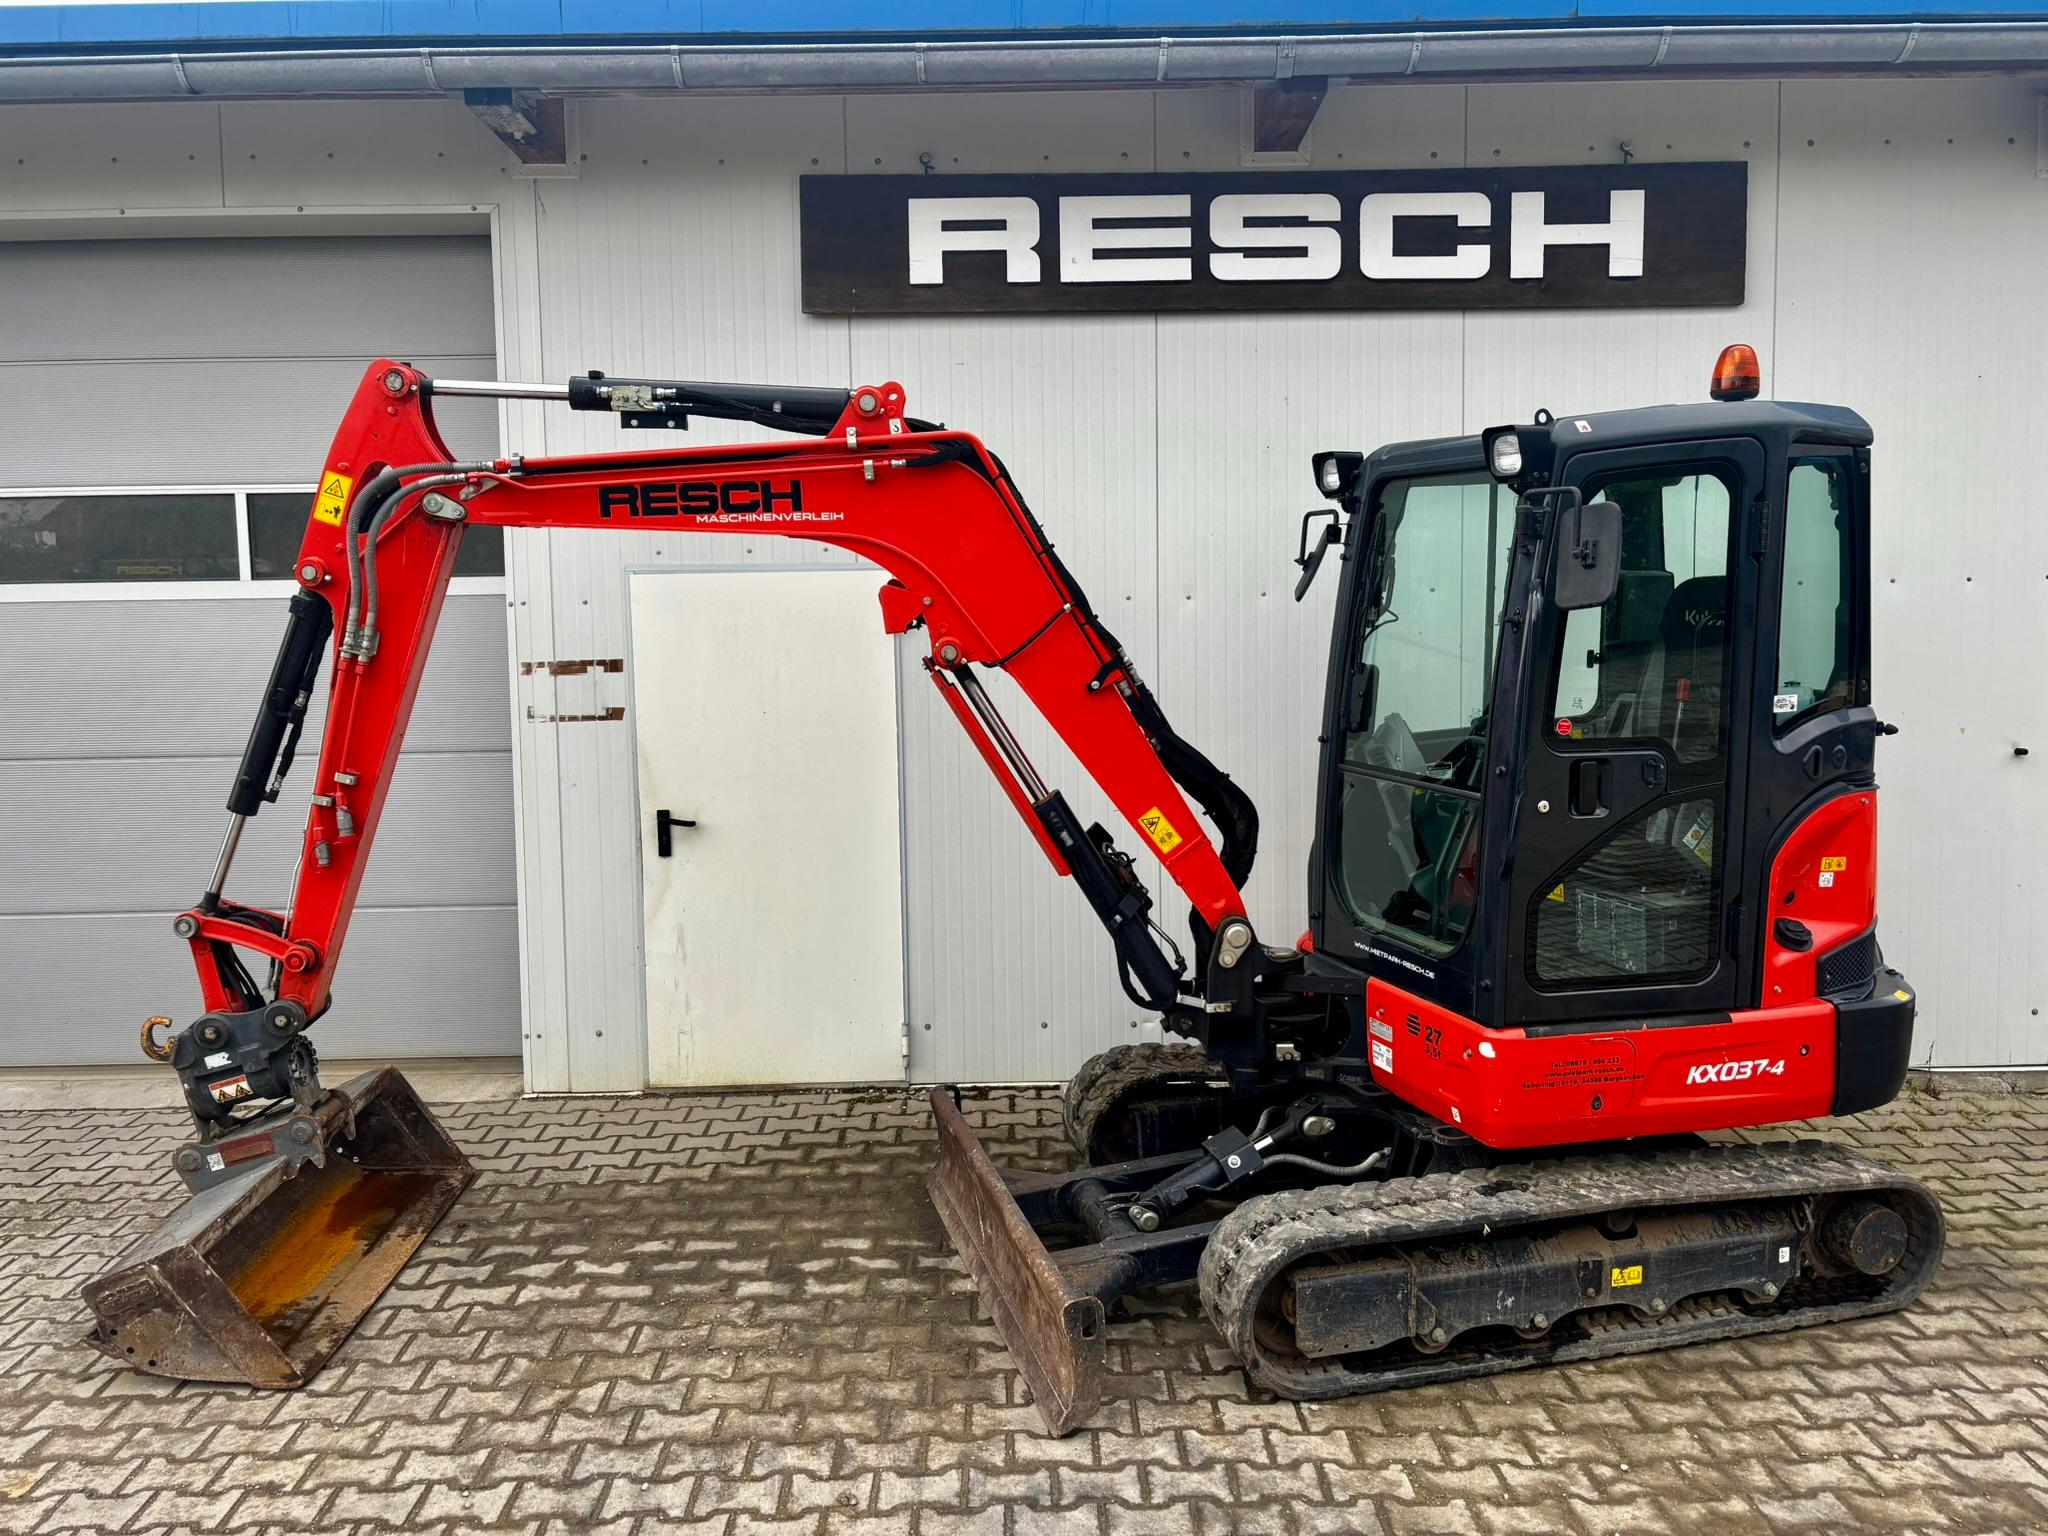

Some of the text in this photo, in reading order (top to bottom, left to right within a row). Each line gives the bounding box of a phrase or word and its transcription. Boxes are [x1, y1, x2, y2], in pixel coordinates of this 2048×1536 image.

[908, 190, 1645, 285] RESCH
[599, 479, 803, 518] RESCH
[696, 511, 844, 524] MASCHINENVERLEIH
[1353, 940, 1436, 980] WWW.MIETPARK-RESCH.DE
[1425, 1025, 1443, 1046] 27
[1686, 1059, 1785, 1085] KX037-4
